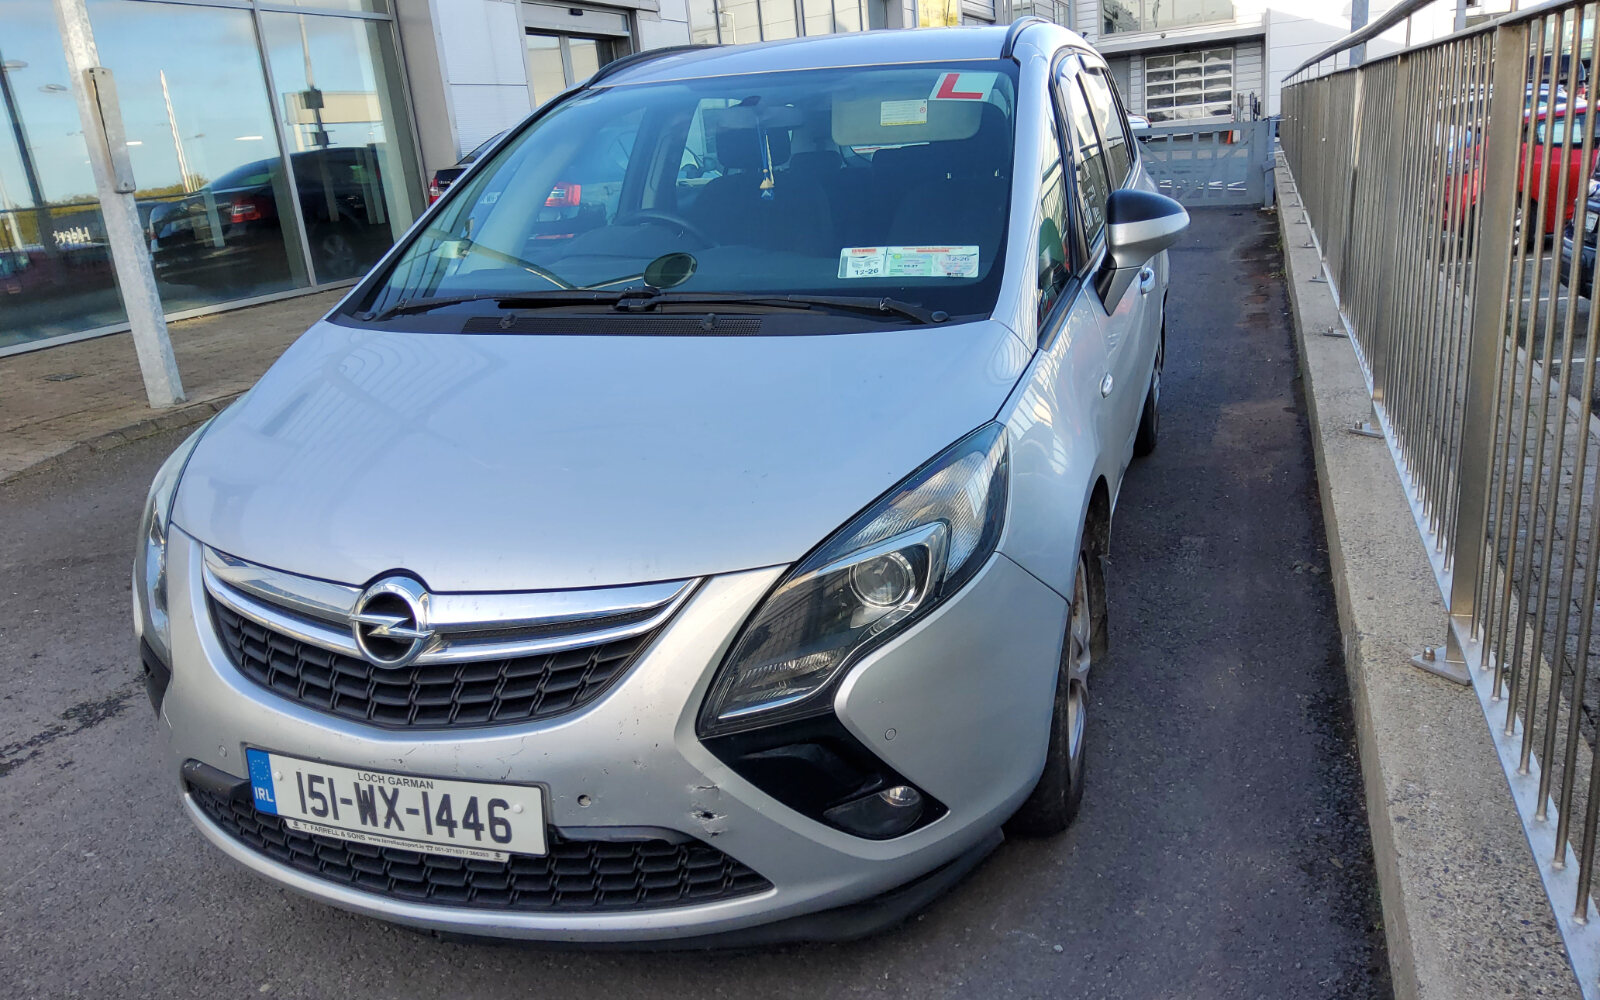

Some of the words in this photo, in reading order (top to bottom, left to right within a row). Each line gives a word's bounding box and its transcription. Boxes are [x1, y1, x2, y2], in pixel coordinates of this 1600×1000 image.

[935, 73, 984, 99] L
[854, 267, 879, 276] 12-26
[357, 772, 385, 784] LOCH
[387, 776, 434, 790] GARMAN
[254, 786, 274, 803] IRL
[296, 771, 513, 844] 151-WX-1446
[303, 823, 310, 831] T.
[310, 825, 340, 837] FARRELL
[346, 832, 366, 841] SONS
